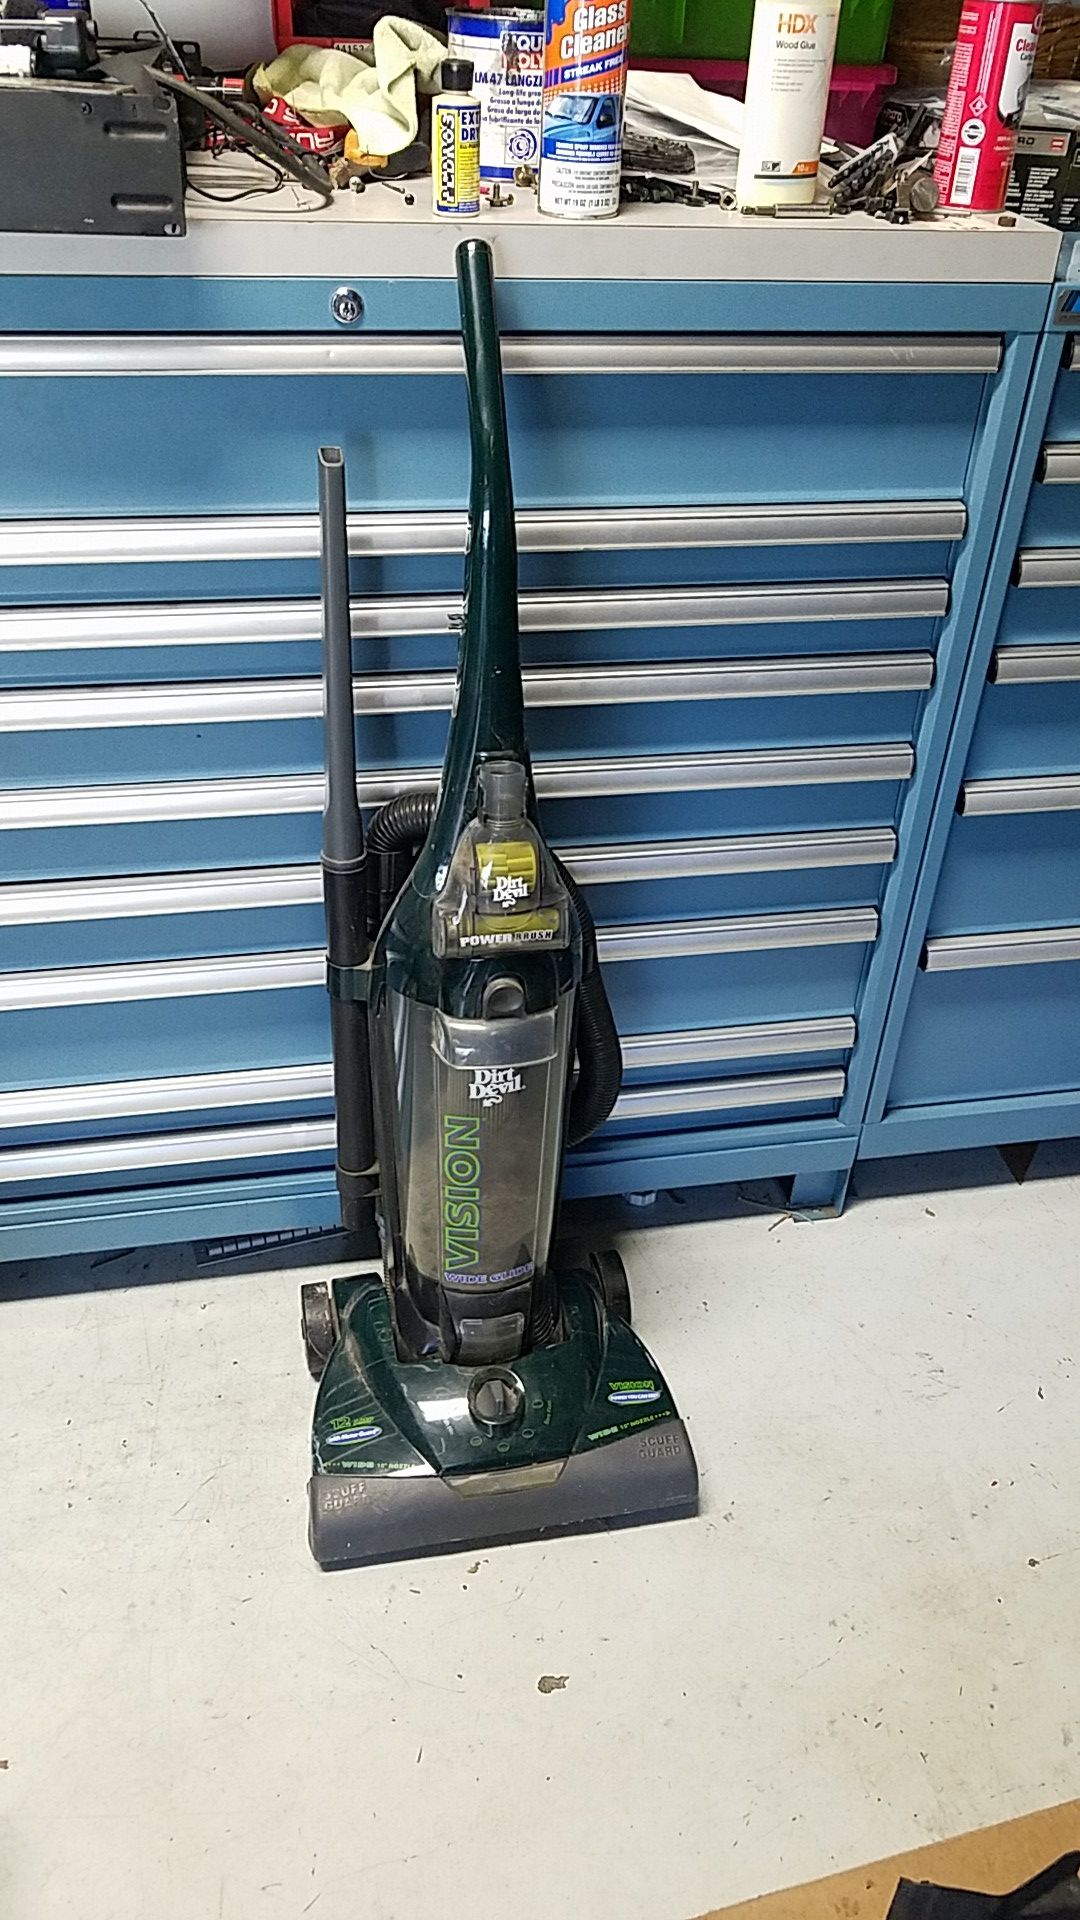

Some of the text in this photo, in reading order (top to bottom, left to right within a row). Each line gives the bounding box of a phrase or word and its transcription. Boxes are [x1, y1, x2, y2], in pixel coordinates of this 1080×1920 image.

[573, 1, 626, 33] Glass
[777, 13, 818, 34] HDX
[560, 23, 631, 60] Cleaner
[776, 40, 816, 50] Wood Glue
[474, 71, 489, 83] LM
[490, 72, 503, 85] 47
[563, 63, 603, 79] STREAK
[495, 876, 524, 890] Dirt
[493, 884, 530, 902] Devil
[460, 930, 553, 947] POWER BRUSH
[474, 1067, 515, 1085] Dirt
[469, 1074, 524, 1100] Devil
[444, 1114, 480, 1271] VISION
[444, 1271, 488, 1284] WIDE
[608, 1380, 655, 1391] VISION
[330, 1416, 351, 1430] 12
[640, 1434, 680, 1448] SCUFF
[639, 1445, 681, 1460] GUARD
